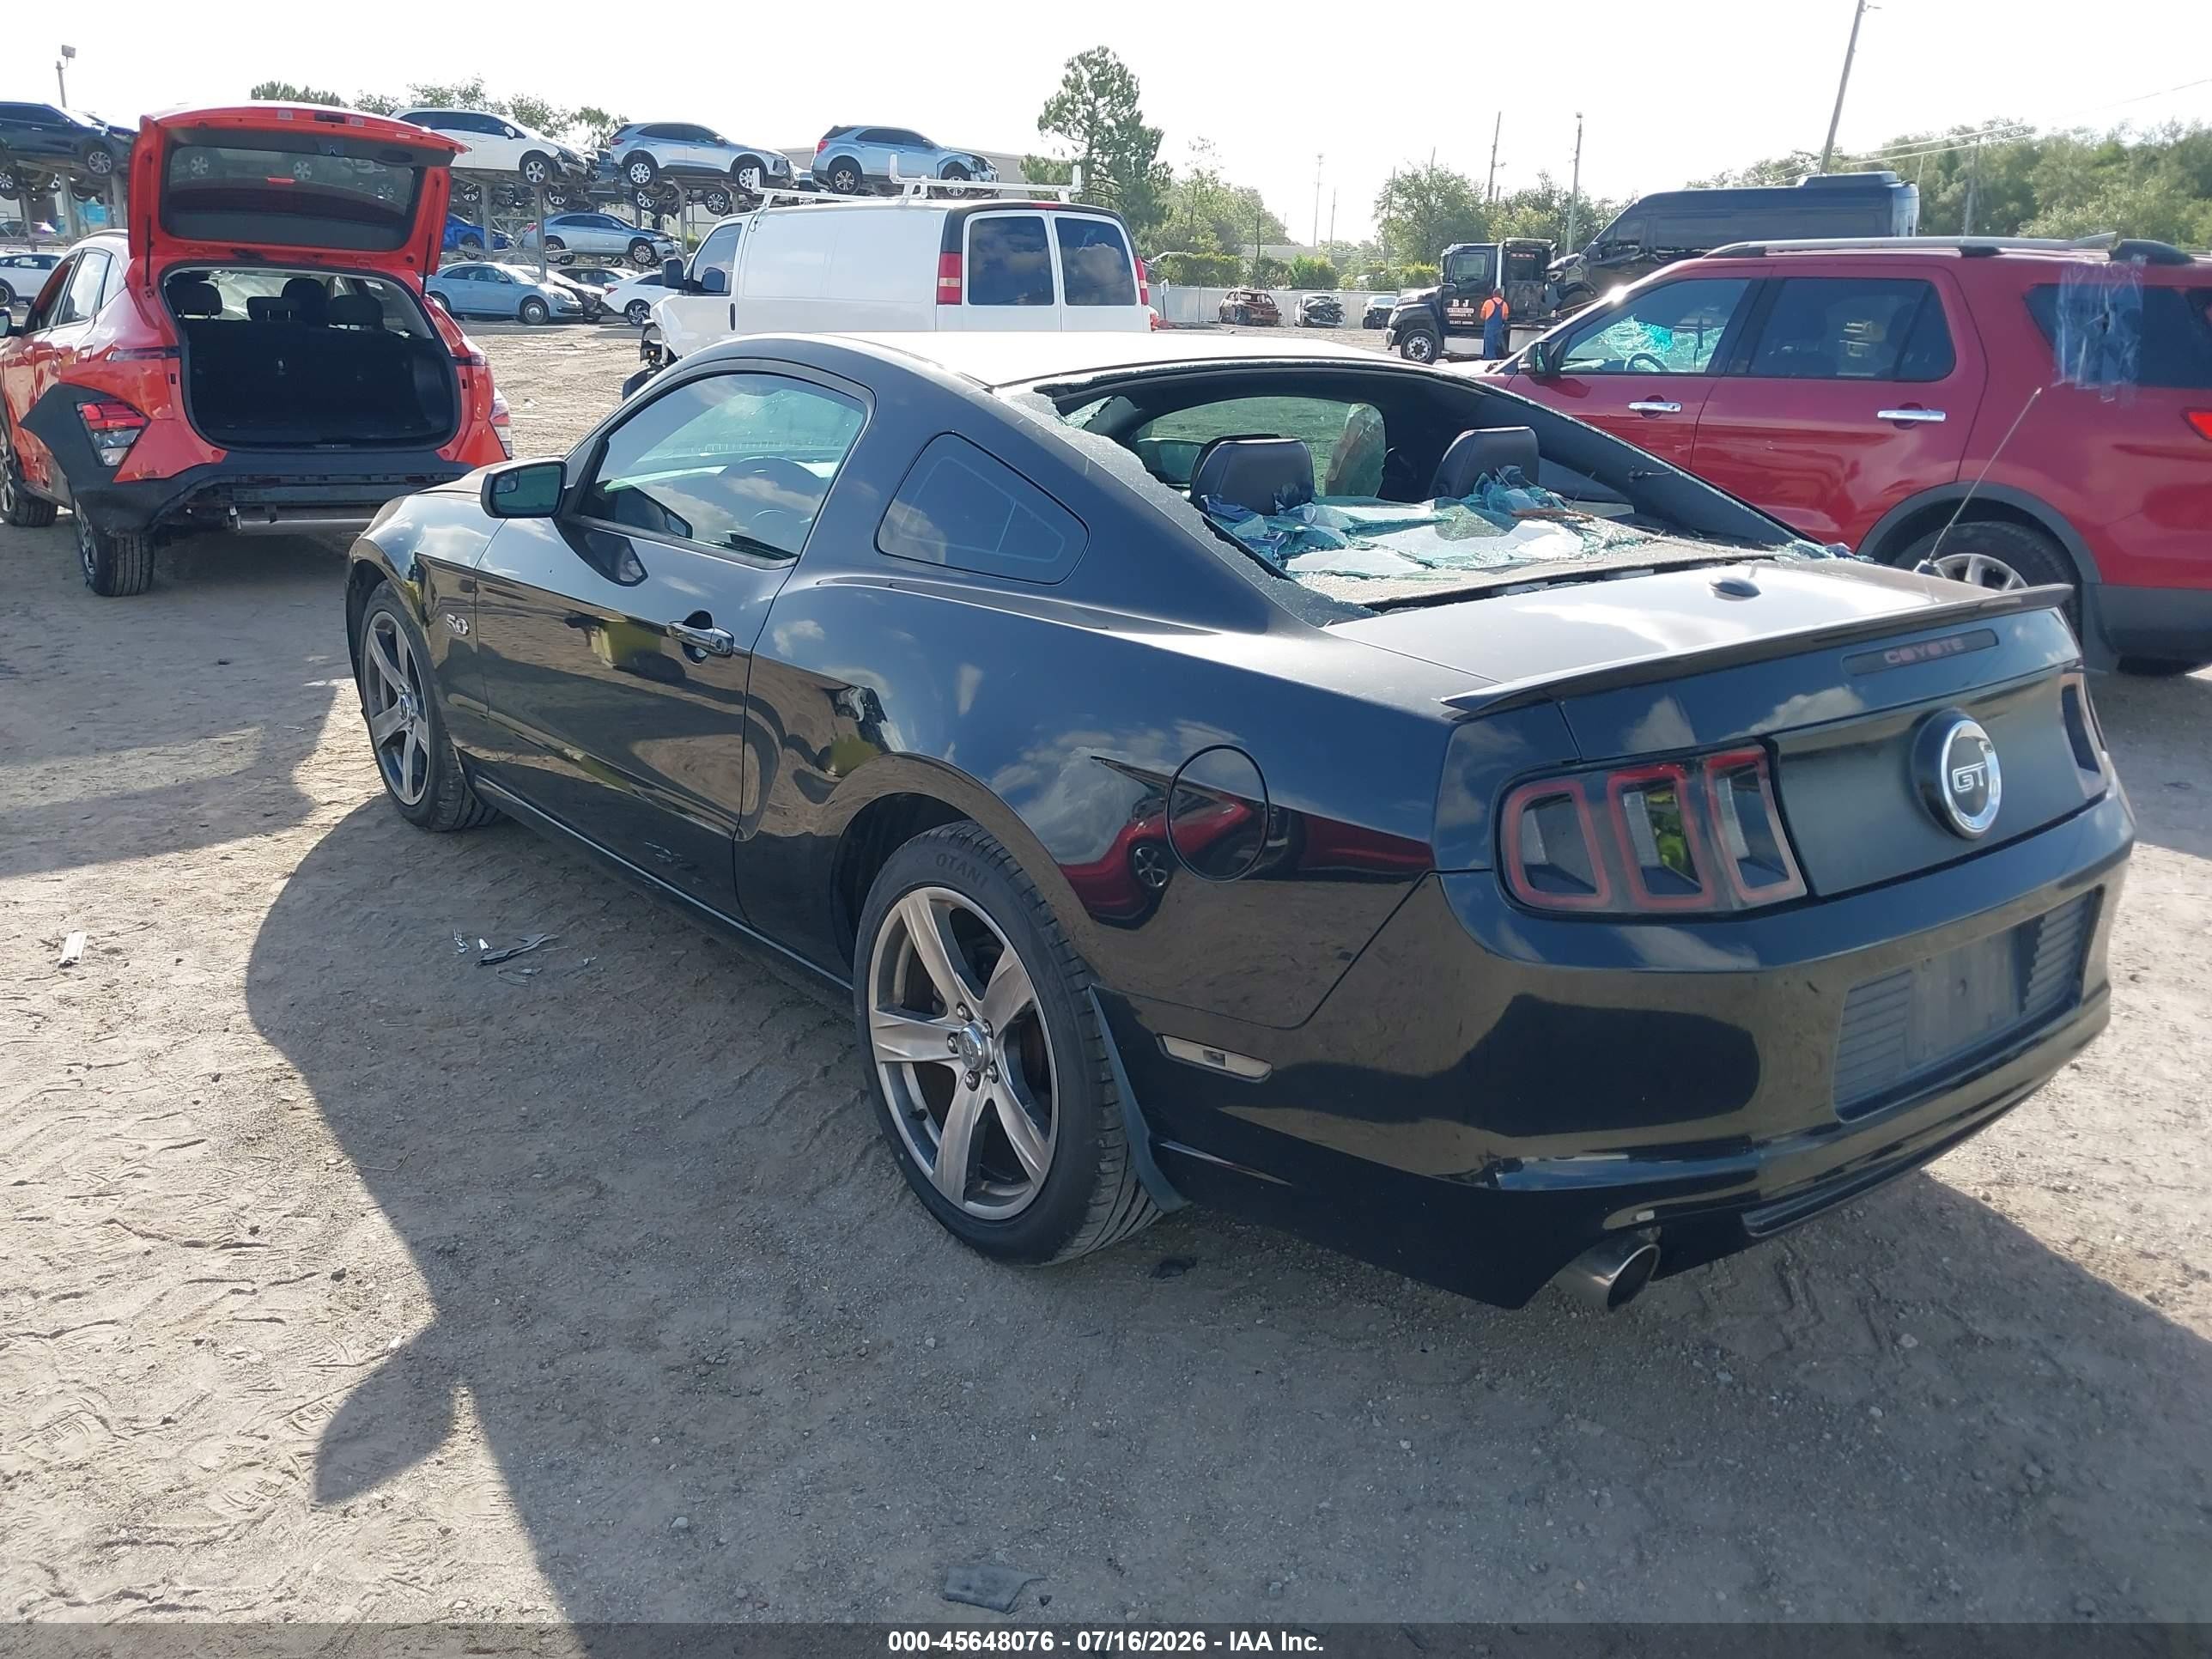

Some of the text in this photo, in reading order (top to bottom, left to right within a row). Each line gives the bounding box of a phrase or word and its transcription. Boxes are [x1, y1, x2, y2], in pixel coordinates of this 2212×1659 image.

[1452, 299, 1470, 307] B J
[1883, 638, 1965, 663] COYOTE
[1952, 761, 1986, 793] GT
